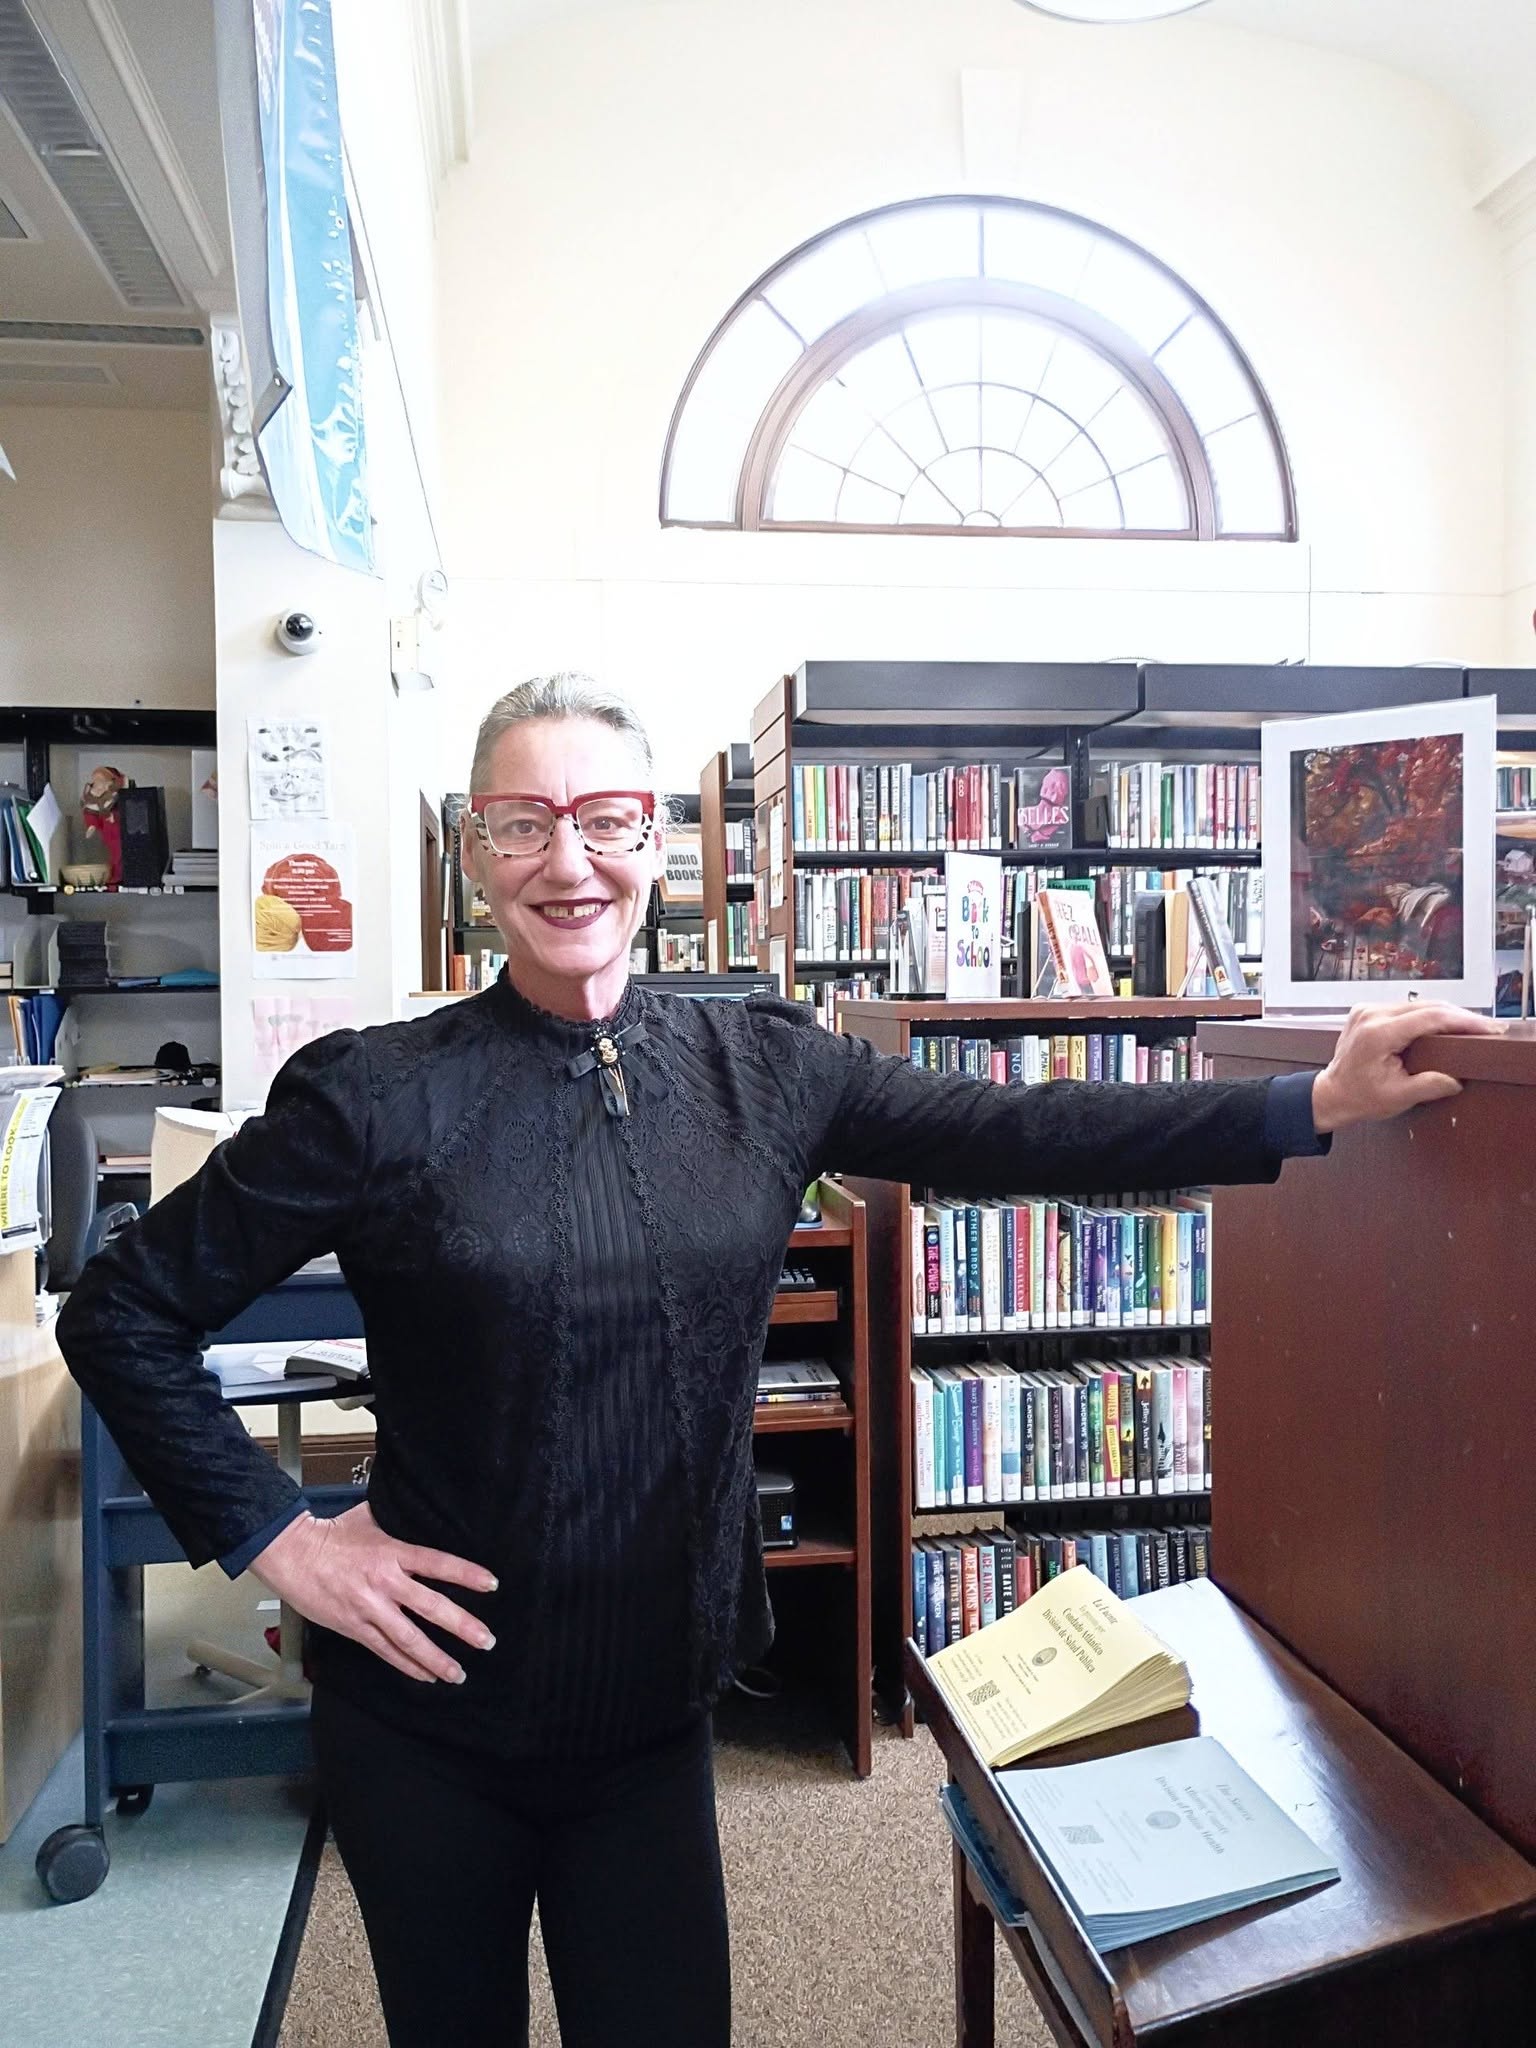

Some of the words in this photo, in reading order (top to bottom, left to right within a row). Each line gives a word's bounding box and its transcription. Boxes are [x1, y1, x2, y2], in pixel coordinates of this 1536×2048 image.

[1018, 806, 1069, 825] BELLES
[666, 870, 703, 881] BOOKS
[962, 896, 989, 924] Back
[2, 1165, 9, 1181] TO
[970, 1210, 978, 1241] OTHER
[928, 1245, 939, 1260] THE
[928, 1263, 939, 1292] POWER
[971, 1406, 979, 1417] kay
[1141, 1401, 1150, 1424] Jeffrey
[949, 1557, 958, 1571] ACE
[965, 1553, 976, 1572] ACE
[982, 1552, 992, 1569] ACE
[1157, 1549, 1168, 1576] DAVID
[1176, 1547, 1185, 1576] DAVID
[1195, 1545, 1205, 1570] DAVID
[950, 1574, 959, 1602] ATKINS
[965, 1574, 977, 1609] ATKINS
[983, 1572, 993, 1604] ATKINS
[1002, 1574, 1012, 1596] KATE
[951, 1606, 959, 1622] THE
[1062, 1607, 1083, 1632] Condado
[1092, 1599, 1102, 1607] La
[1098, 1607, 1118, 1623] Fuente
[1058, 1629, 1066, 1638] de
[1064, 1634, 1081, 1653] Salud
